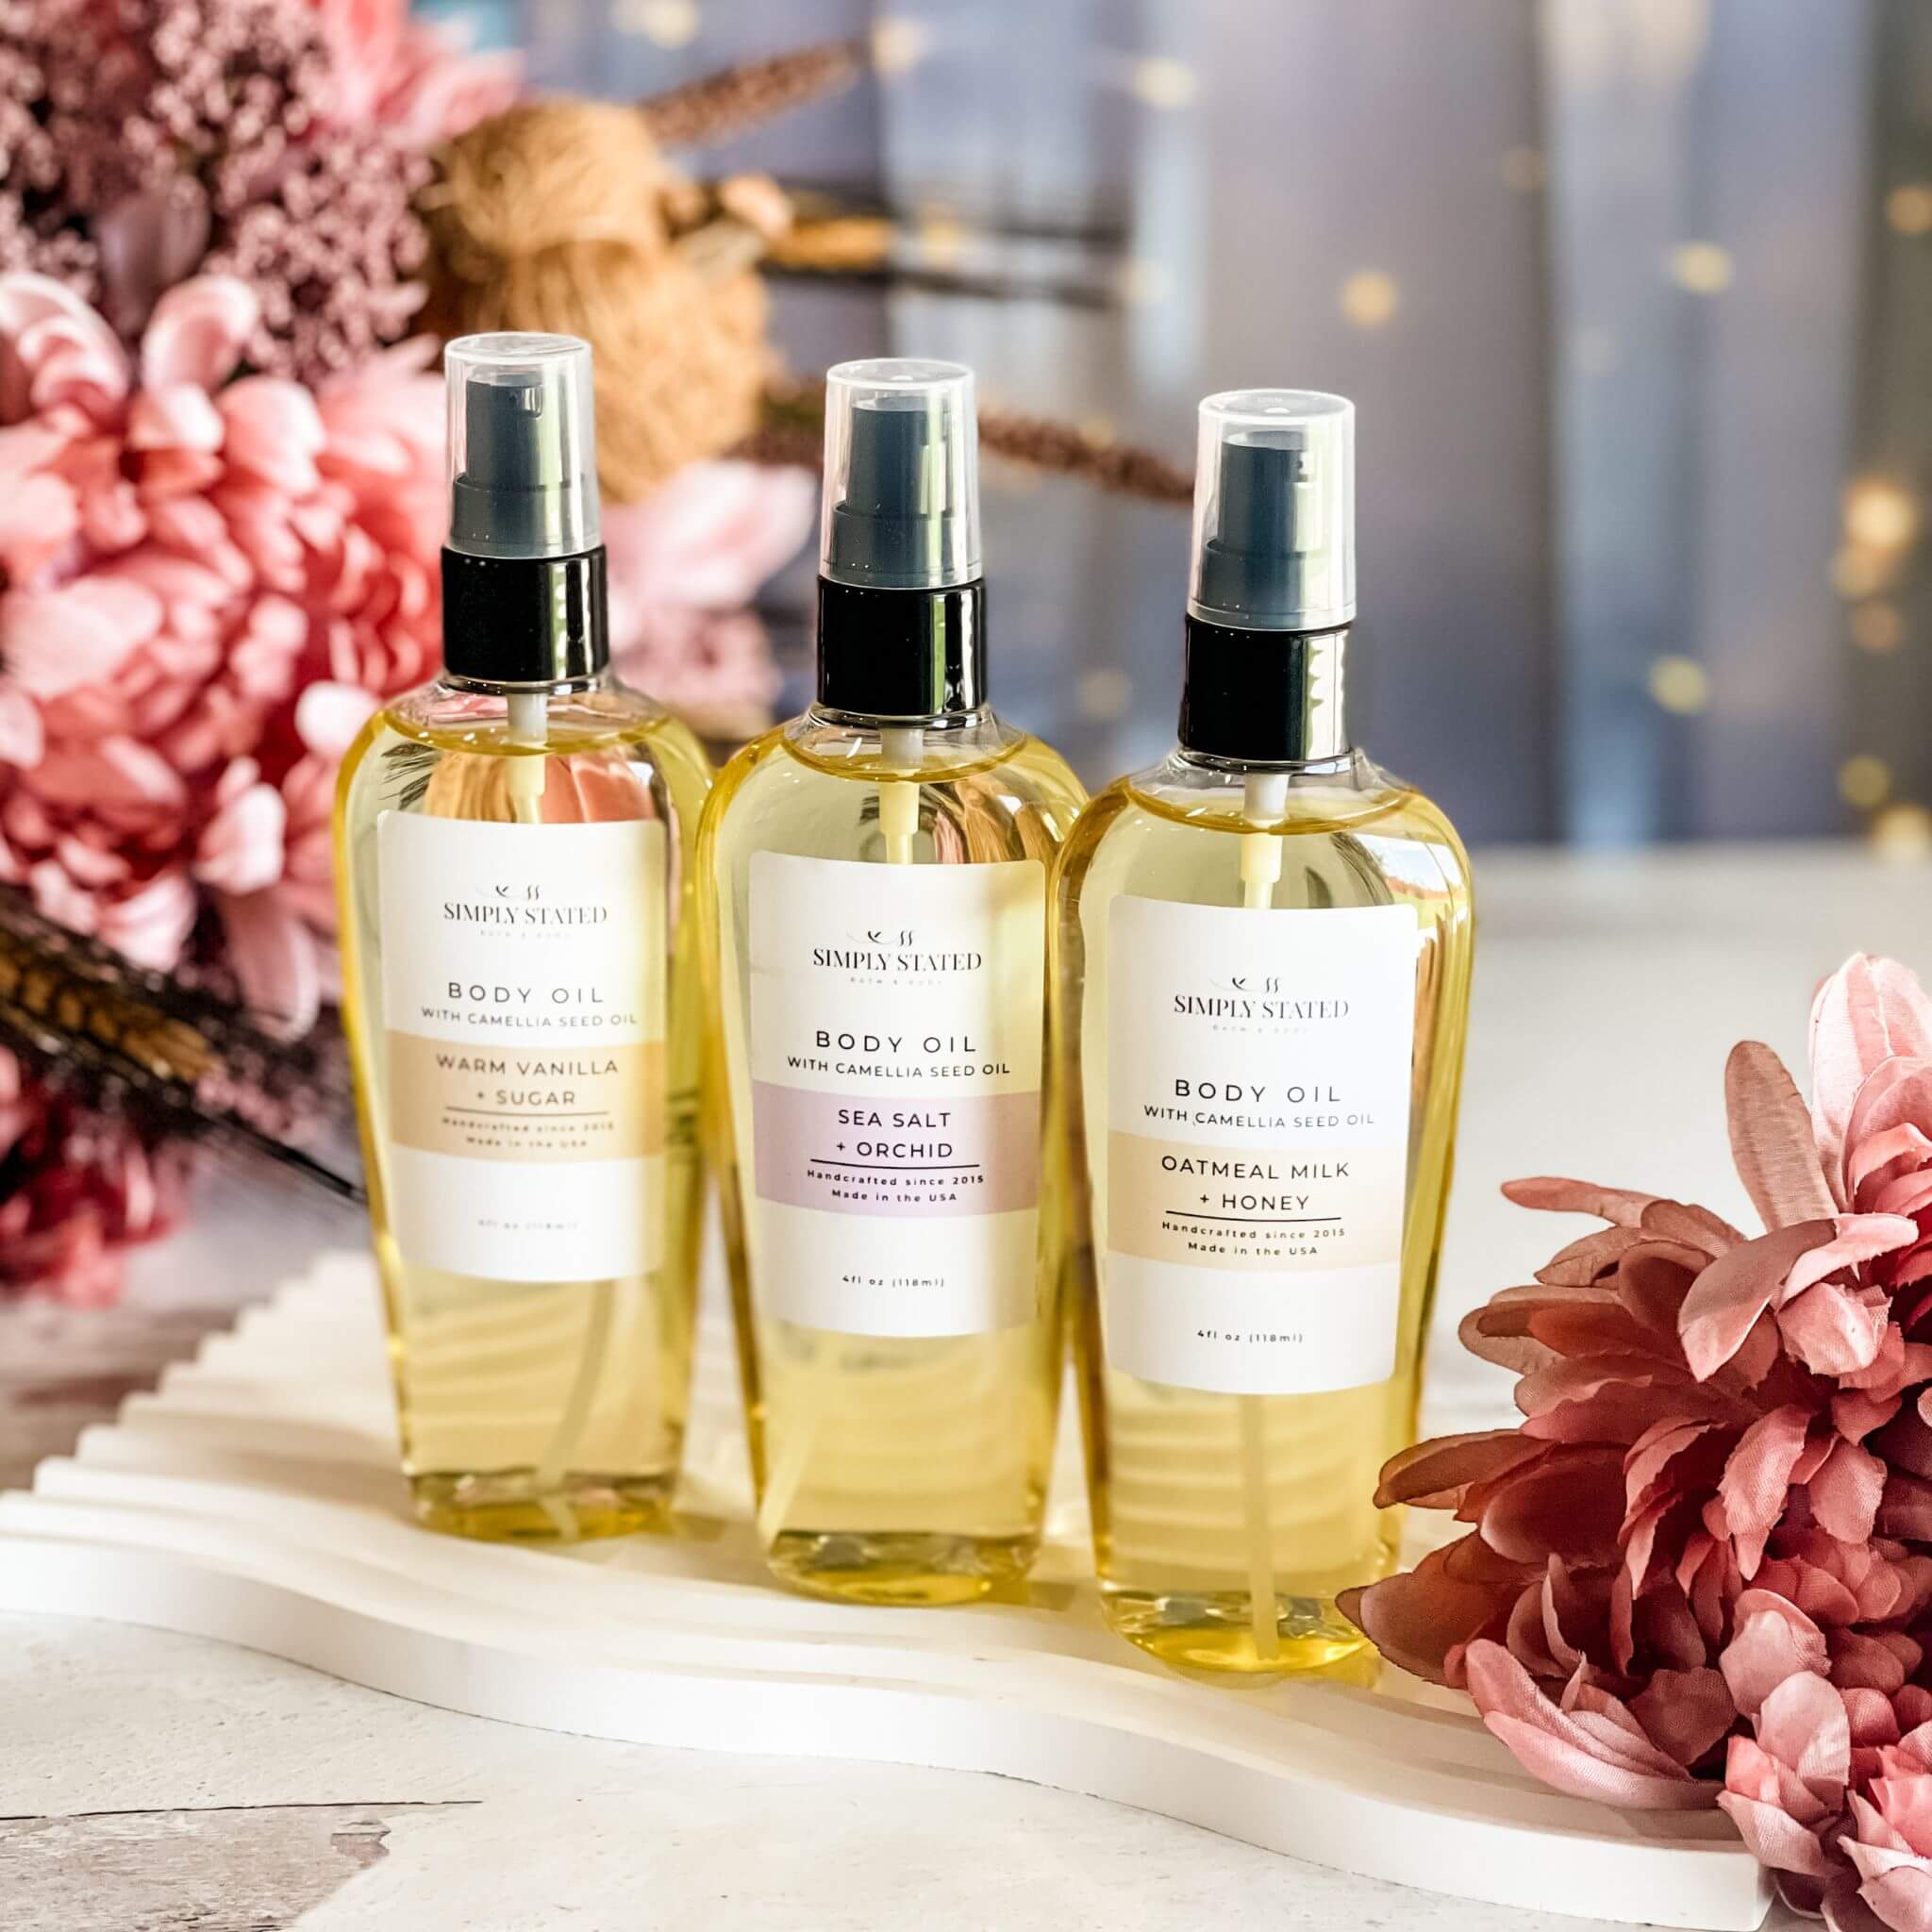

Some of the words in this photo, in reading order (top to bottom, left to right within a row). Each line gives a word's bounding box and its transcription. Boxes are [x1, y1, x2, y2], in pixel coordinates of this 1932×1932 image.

[443, 901, 520, 925] SIMPLY
[524, 905, 608, 925] STATED
[812, 947, 892, 972] SIMPLY
[897, 952, 982, 972] STATED
[448, 981, 531, 1004] BODY
[551, 988, 604, 1005] OIL
[421, 1006, 461, 1022] WITH
[467, 1012, 553, 1028] CAMELLIA
[558, 1014, 604, 1028] SEED
[609, 1012, 639, 1025] OIL
[1174, 994, 1257, 1019] SIMPLY
[1261, 999, 1350, 1020] STATED
[816, 1030, 903, 1054] BODY
[923, 1035, 976, 1054] OIL
[436, 1053, 507, 1075] WARM
[517, 1059, 619, 1076] VANILLA
[787, 1055, 829, 1072] WITH
[835, 1061, 923, 1078] CAMELLIA
[930, 1065, 975, 1078] SEED
[982, 1062, 1011, 1076] OIL
[496, 1089, 576, 1107] SUGAR
[1174, 1078, 1266, 1103] BODY
[1287, 1085, 1341, 1104] OIL
[838, 1108, 883, 1127] SEA
[892, 1111, 952, 1128] SALT
[1143, 1104, 1188, 1122] WITH
[1194, 1111, 1286, 1128] CAMELLIA
[1293, 1114, 1340, 1128] SEED
[1346, 1112, 1374, 1125] OIL
[836, 1141, 846, 1152] +
[856, 1141, 954, 1158] ORCHID
[807, 1169, 898, 1187] Handcrafted
[905, 1176, 944, 1187] since
[952, 1174, 984, 1186] 2015
[1161, 1155, 1279, 1180] OATMEAL
[1291, 1161, 1350, 1179] MILK
[831, 1189, 868, 1201] Made
[875, 1191, 889, 1202] in
[896, 1192, 921, 1203] the
[929, 1191, 958, 1203] USA
[1199, 1193, 1210, 1204] +
[1222, 1192, 1309, 1211] HONEY
[1161, 1221, 1257, 1240] Handcrafted
[1265, 1229, 1306, 1240] since
[1313, 1227, 1345, 1239] 2015
[1188, 1241, 1226, 1255] Made
[1234, 1246, 1248, 1256] in
[1256, 1246, 1281, 1257] the
[1289, 1246, 1318, 1256] USA
